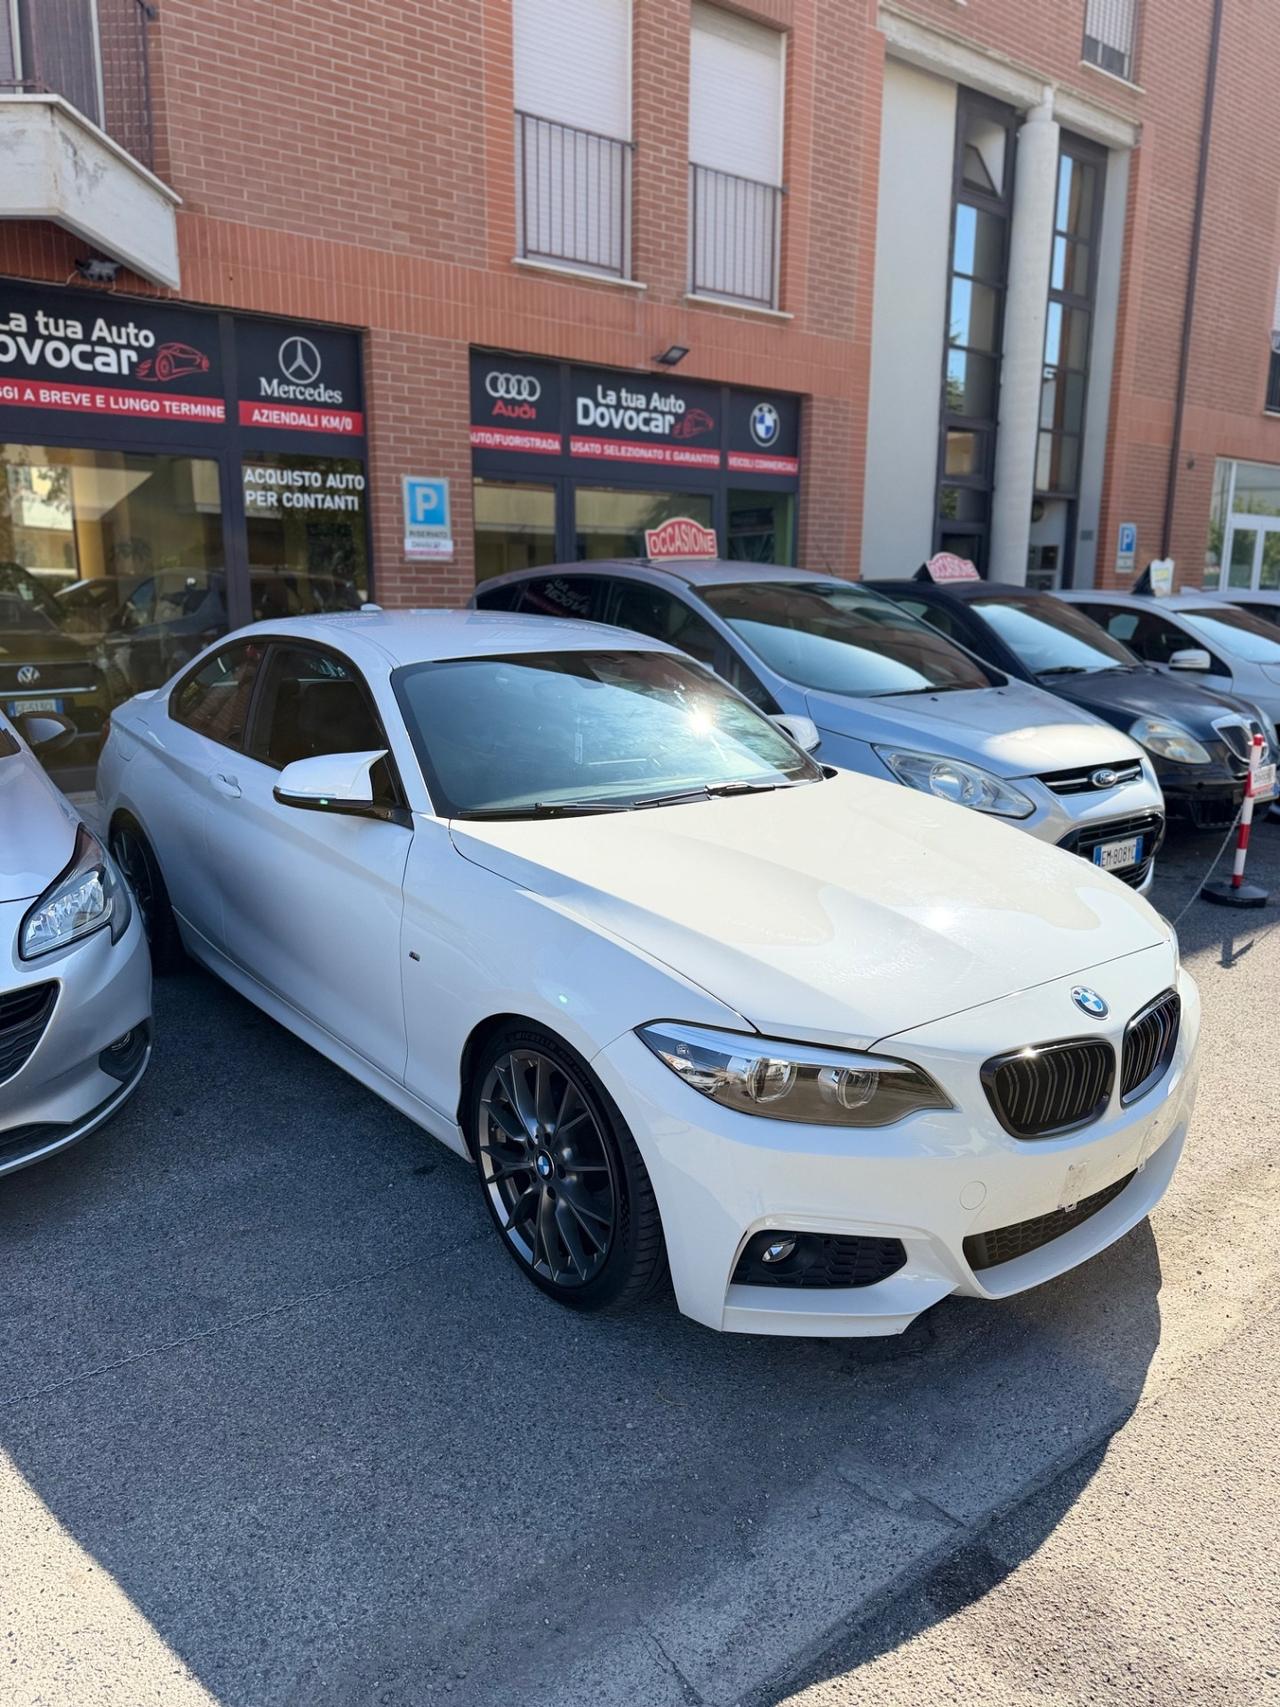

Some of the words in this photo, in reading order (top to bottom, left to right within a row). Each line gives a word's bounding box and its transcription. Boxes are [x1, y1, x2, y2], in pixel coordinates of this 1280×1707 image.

[35, 310, 84, 340] tua
[91, 318, 155, 348] Auto
[24, 388, 35, 402] A
[39, 389, 92, 407] BREVE
[95, 394, 106, 408] E
[110, 396, 160, 413] LUNGO
[162, 400, 226, 419] TERMINE
[259, 376, 343, 404] Mercedes
[597, 384, 617, 406] La
[620, 387, 646, 409] tua
[649, 392, 685, 414] Auto
[252, 408, 320, 428] AZIENDALI
[321, 414, 353, 432] KM/0
[491, 399, 537, 420] Audi
[576, 396, 675, 435] Dovocar
[569, 440, 602, 455] USATO
[603, 443, 663, 460] SELEZIONATO
[664, 450, 673, 460] E
[672, 450, 720, 466] GARANTITO
[244, 467, 322, 488] ACQUISTO
[325, 473, 366, 491] AUTO
[245, 490, 278, 507] PER
[282, 490, 360, 512] CONTANTI
[415, 486, 438, 522] P
[650, 523, 715, 554] OCCASIONE
